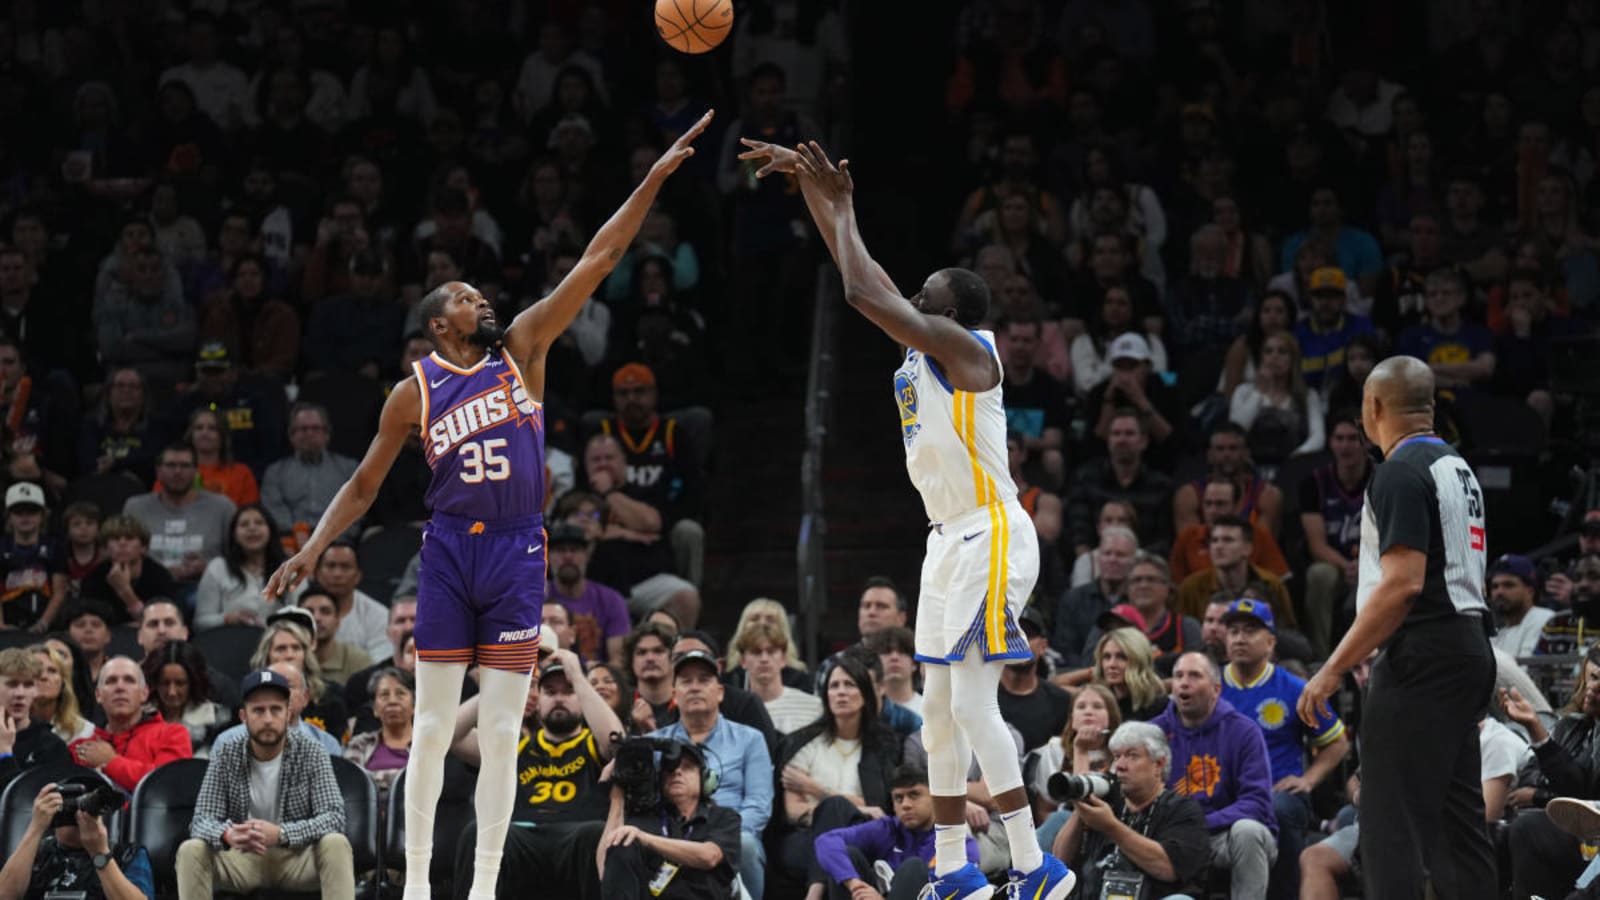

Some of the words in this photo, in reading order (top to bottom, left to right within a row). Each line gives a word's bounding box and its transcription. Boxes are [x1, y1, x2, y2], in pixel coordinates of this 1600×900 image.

[902, 386, 914, 406] 23
[430, 389, 509, 455] SUNS
[458, 438, 510, 483] 35
[528, 781, 577, 804] 30
